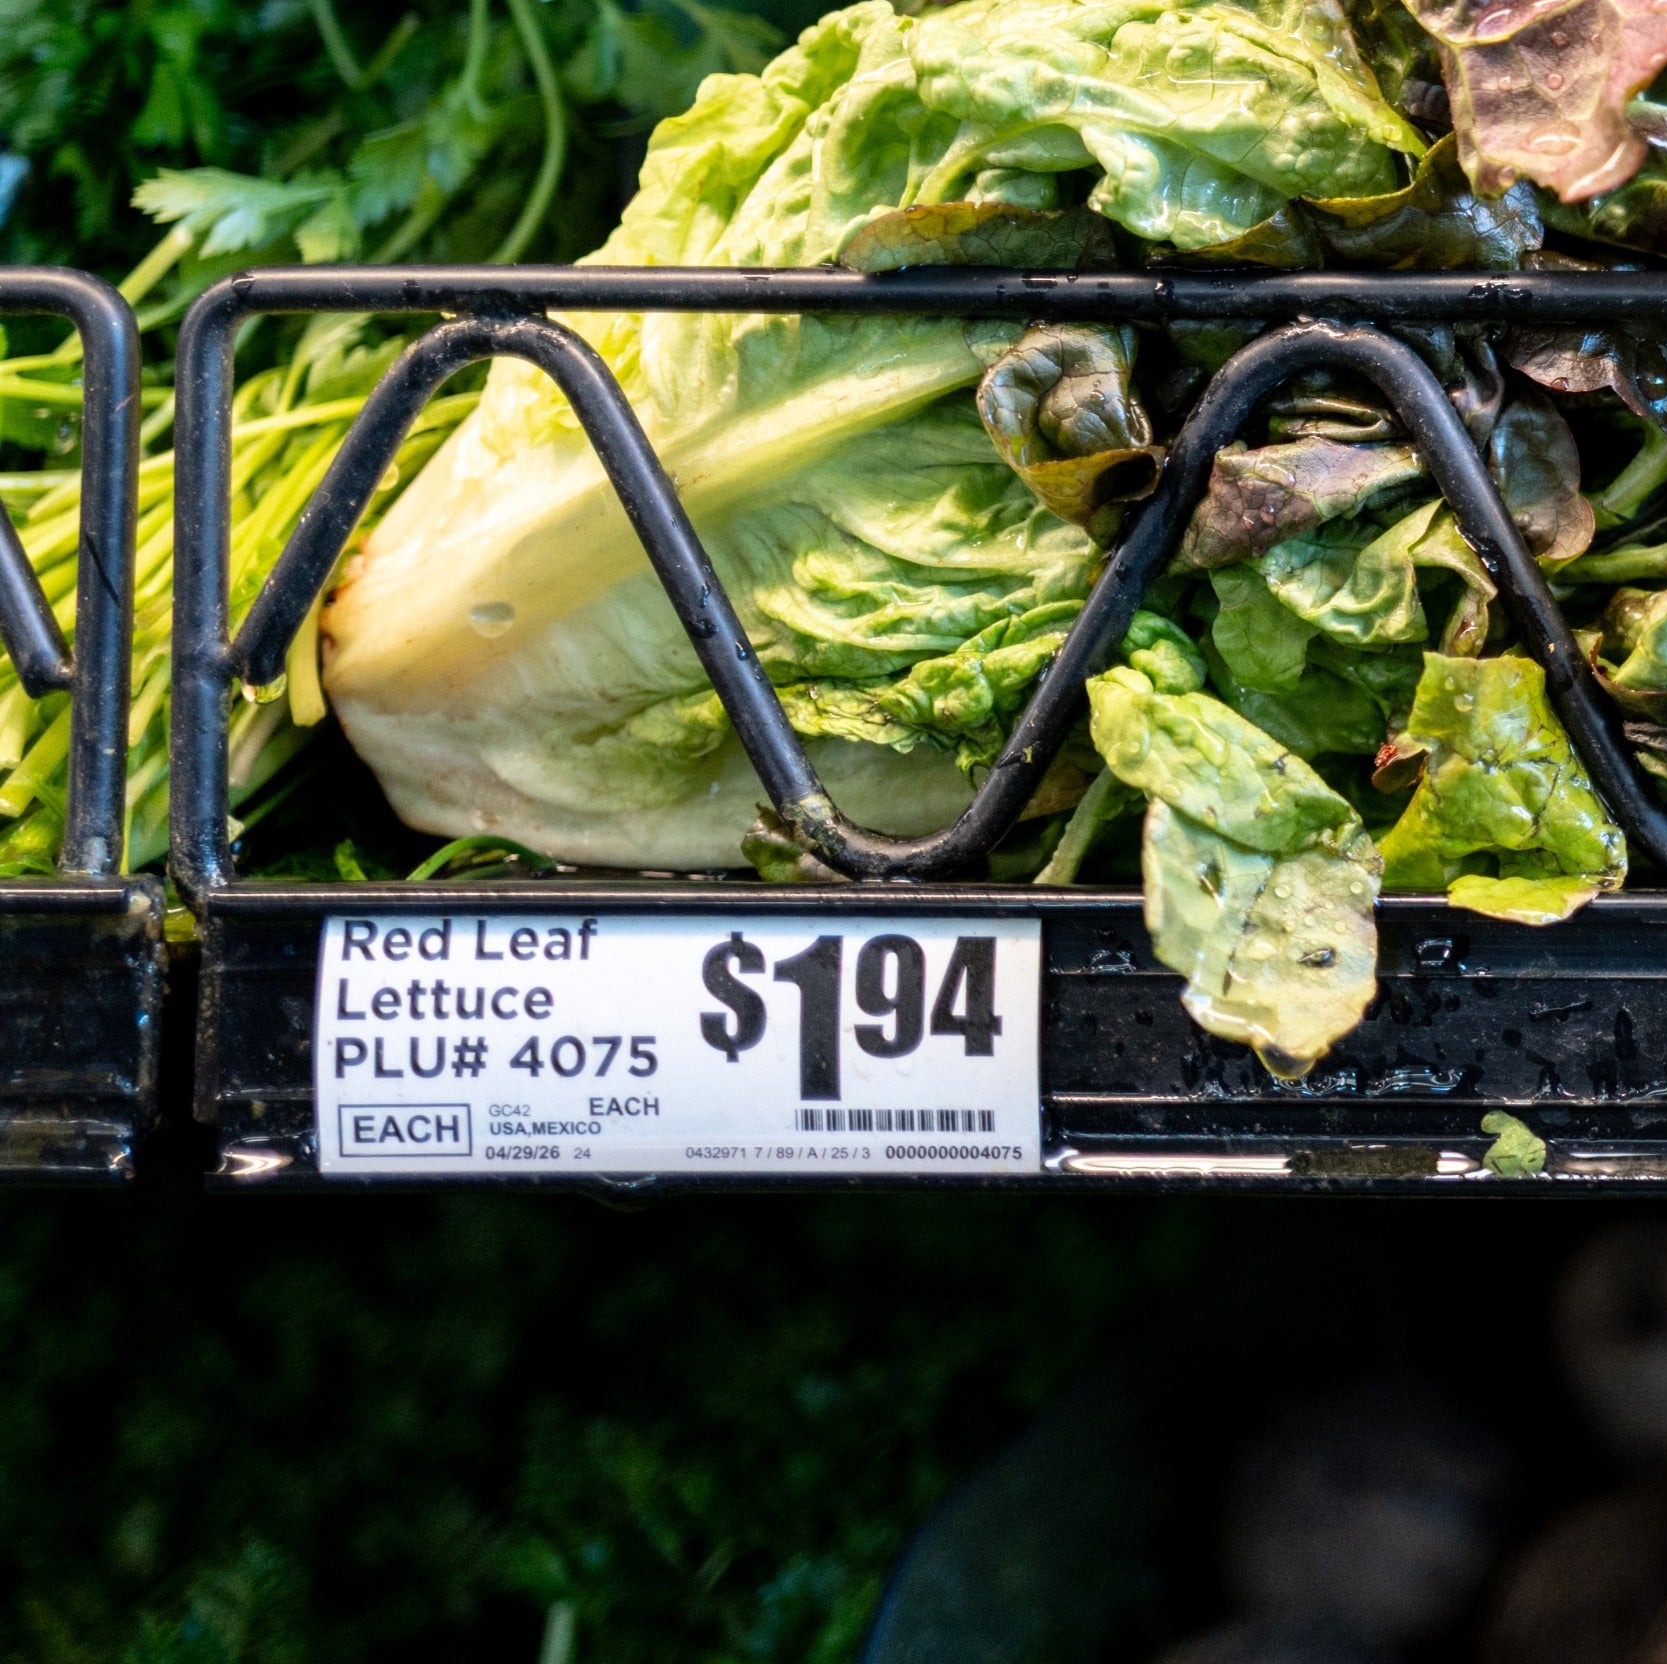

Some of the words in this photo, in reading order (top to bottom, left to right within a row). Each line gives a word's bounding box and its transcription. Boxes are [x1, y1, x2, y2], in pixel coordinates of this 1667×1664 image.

[340, 919, 453, 961] Red
[475, 919, 599, 961] Leaf
[337, 978, 554, 1021] Lettuce
[335, 1036, 488, 1079] PLU#
[509, 1035, 659, 1079] 4075
[488, 1104, 531, 1119] GC42
[589, 1097, 660, 1116] EACH
[352, 1115, 460, 1144] EACH
[489, 1121, 602, 1137] USA,MEXICO
[485, 1145, 560, 1160] 04/29/26
[574, 1147, 592, 1160] 24
[685, 1147, 746, 1160] 0432971
[885, 1145, 1023, 1161] 0000000004075
